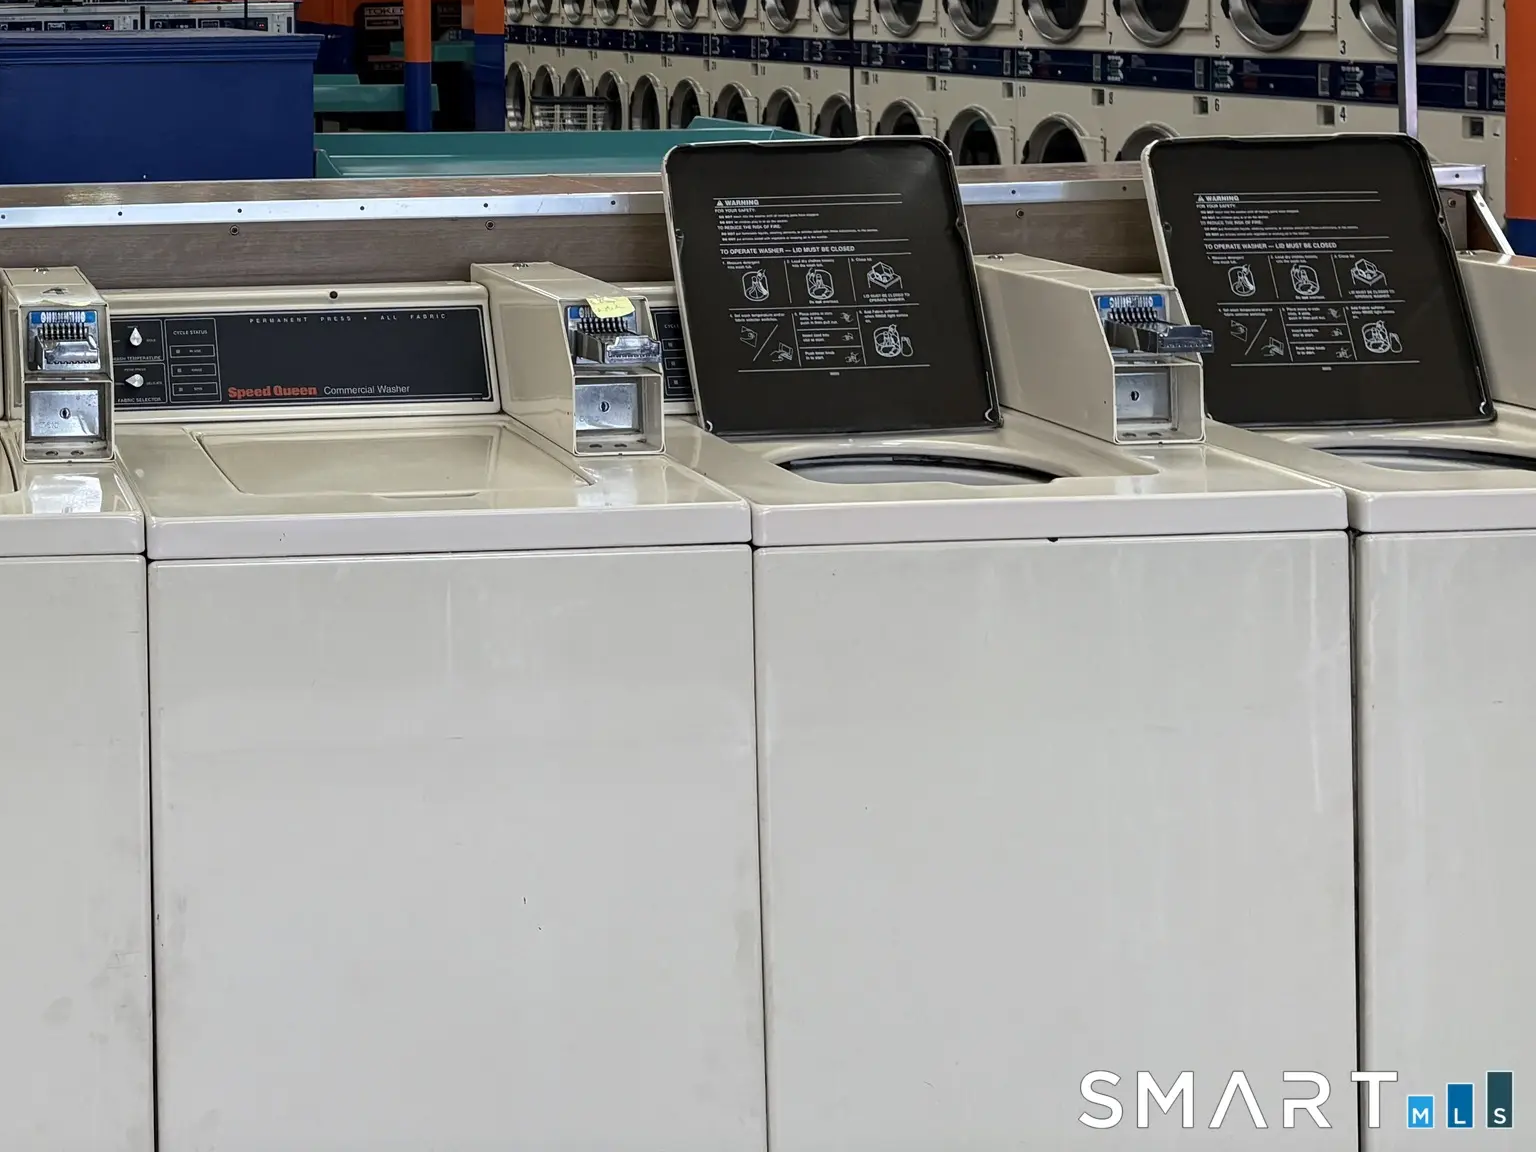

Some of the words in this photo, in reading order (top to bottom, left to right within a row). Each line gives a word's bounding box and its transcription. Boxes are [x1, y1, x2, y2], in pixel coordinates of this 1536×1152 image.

[1019, 30, 1023, 40] 9
[1109, 32, 1113, 44] 7
[1215, 35, 1220, 48] 5
[1340, 41, 1346, 55] 3
[1496, 44, 1499, 59] 1
[940, 80, 948, 91] 12
[1019, 86, 1026, 97] 10
[1109, 92, 1113, 104] 8
[1215, 99, 1219, 111] 6
[1340, 106, 1346, 121] 4
[228, 387, 270, 399] Speed
[273, 385, 317, 396] Queen
[323, 385, 374, 395] Commercial
[377, 384, 410, 394] Washer
